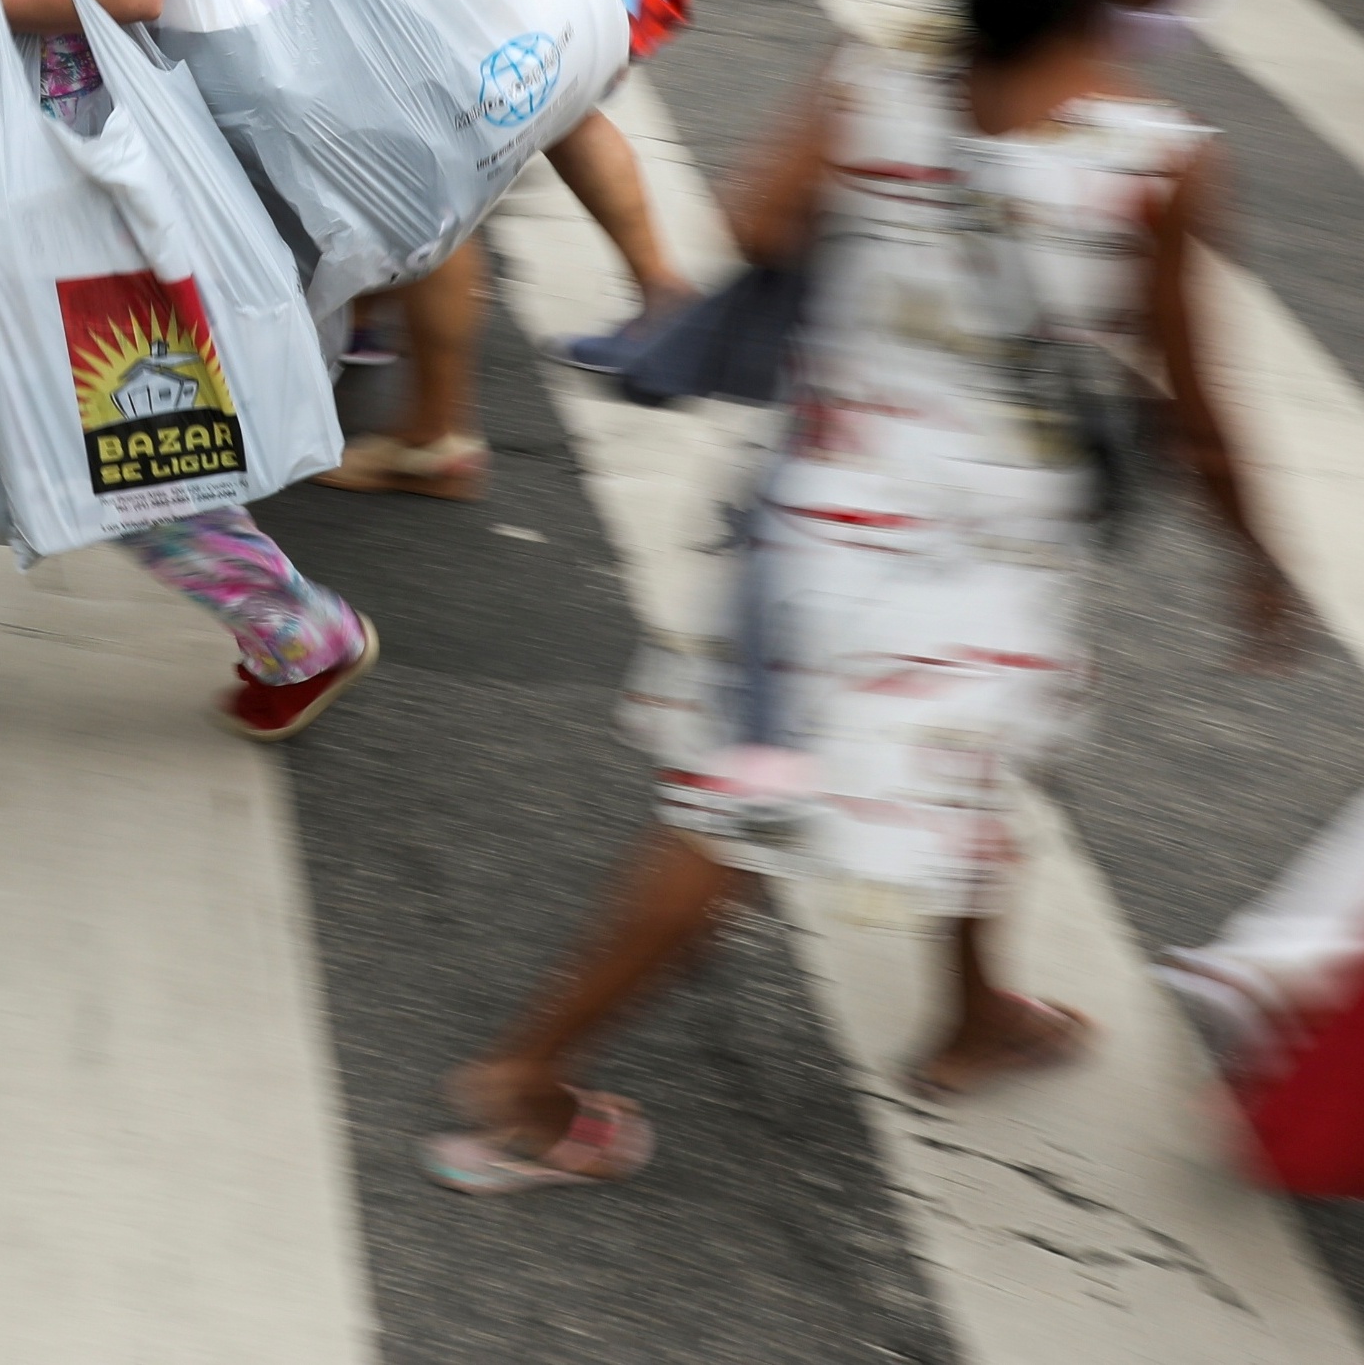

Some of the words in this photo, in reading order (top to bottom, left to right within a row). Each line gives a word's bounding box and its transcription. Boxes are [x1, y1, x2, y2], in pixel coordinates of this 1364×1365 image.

[96, 421, 234, 463] BAZAR
[100, 462, 143, 485] SE
[150, 450, 239, 479] LIGUE
